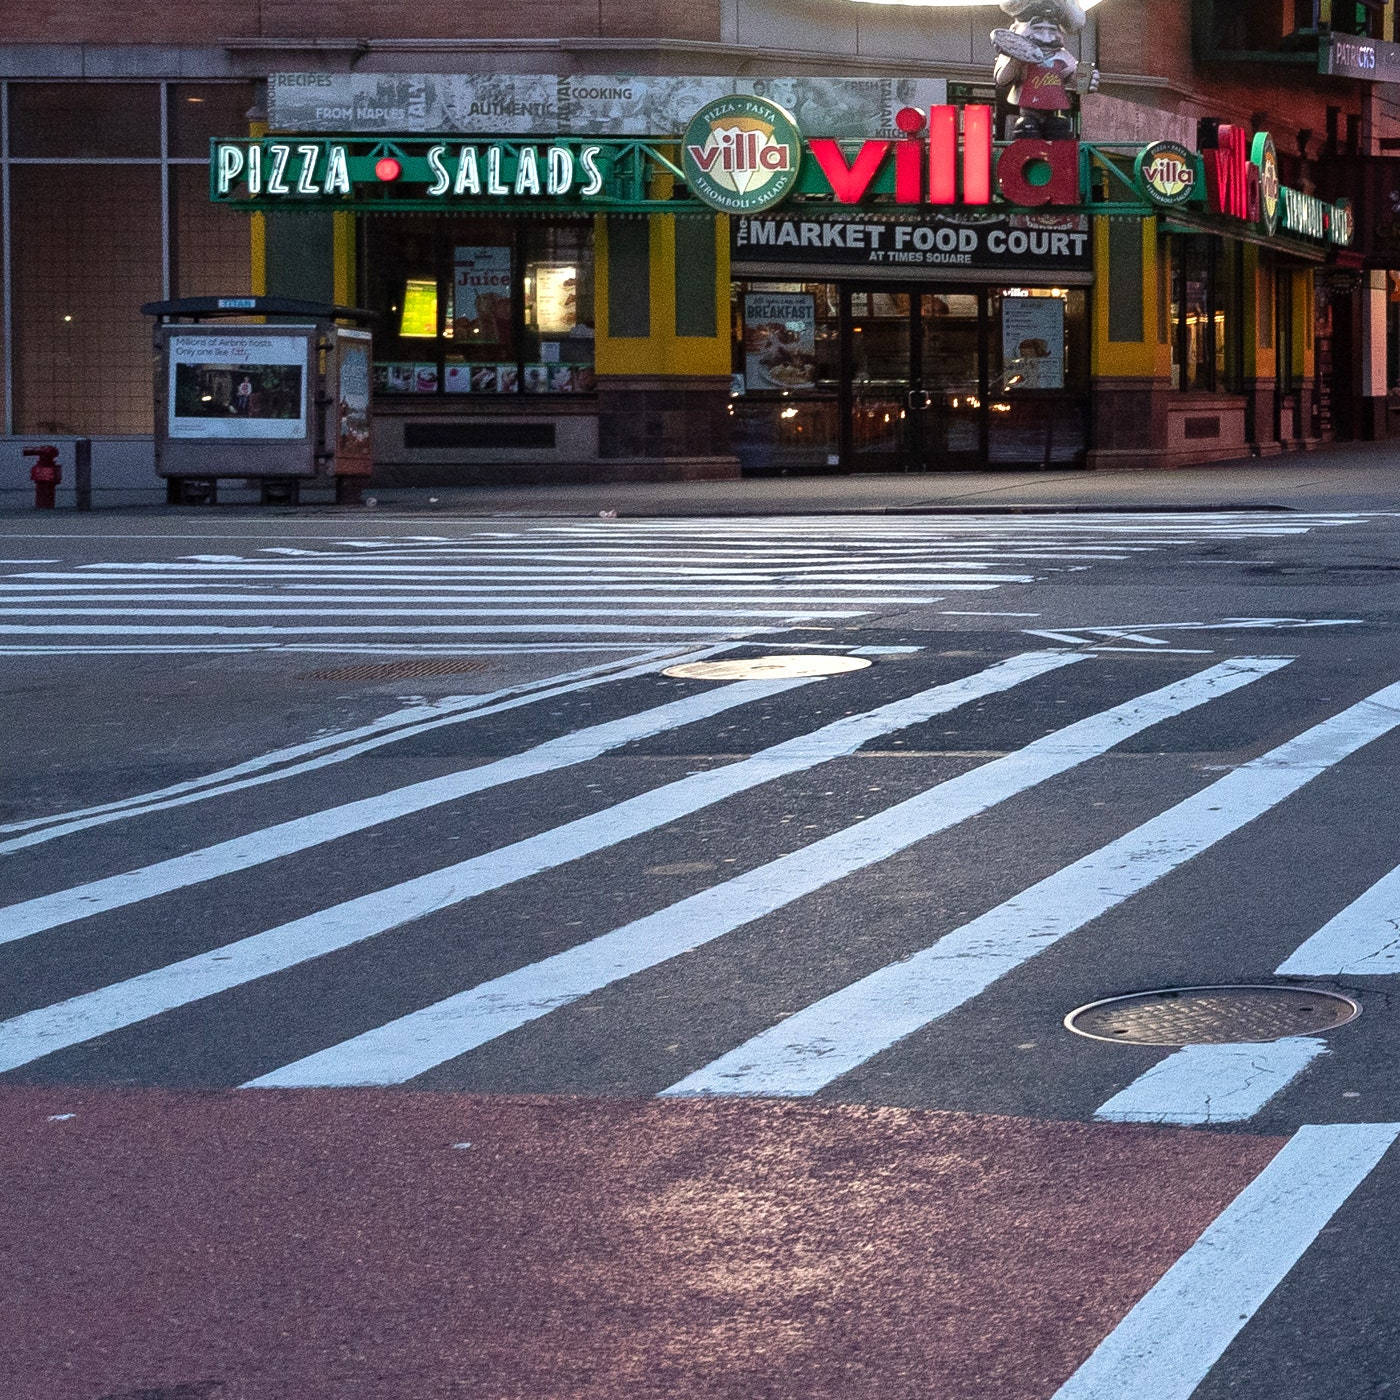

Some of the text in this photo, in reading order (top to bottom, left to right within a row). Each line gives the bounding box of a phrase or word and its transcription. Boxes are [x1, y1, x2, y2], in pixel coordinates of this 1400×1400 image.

[277, 73, 333, 87] RECIPES
[572, 87, 633, 100] COOKING
[316, 107, 351, 119] FROM
[704, 103, 776, 123] PIZZA PASTA
[687, 132, 790, 173] villa
[807, 104, 1079, 206] villa
[218, 144, 604, 197] PIZZA SALADS
[1142, 159, 1194, 184] villa
[696, 176, 788, 208] STROMBOLI SALADS
[737, 218, 1088, 257] The MARKET FOOD COURT
[868, 251, 973, 265] AT TIMES SQUARE
[457, 271, 510, 287] Juice
[747, 304, 813, 319] BREAKFAST
